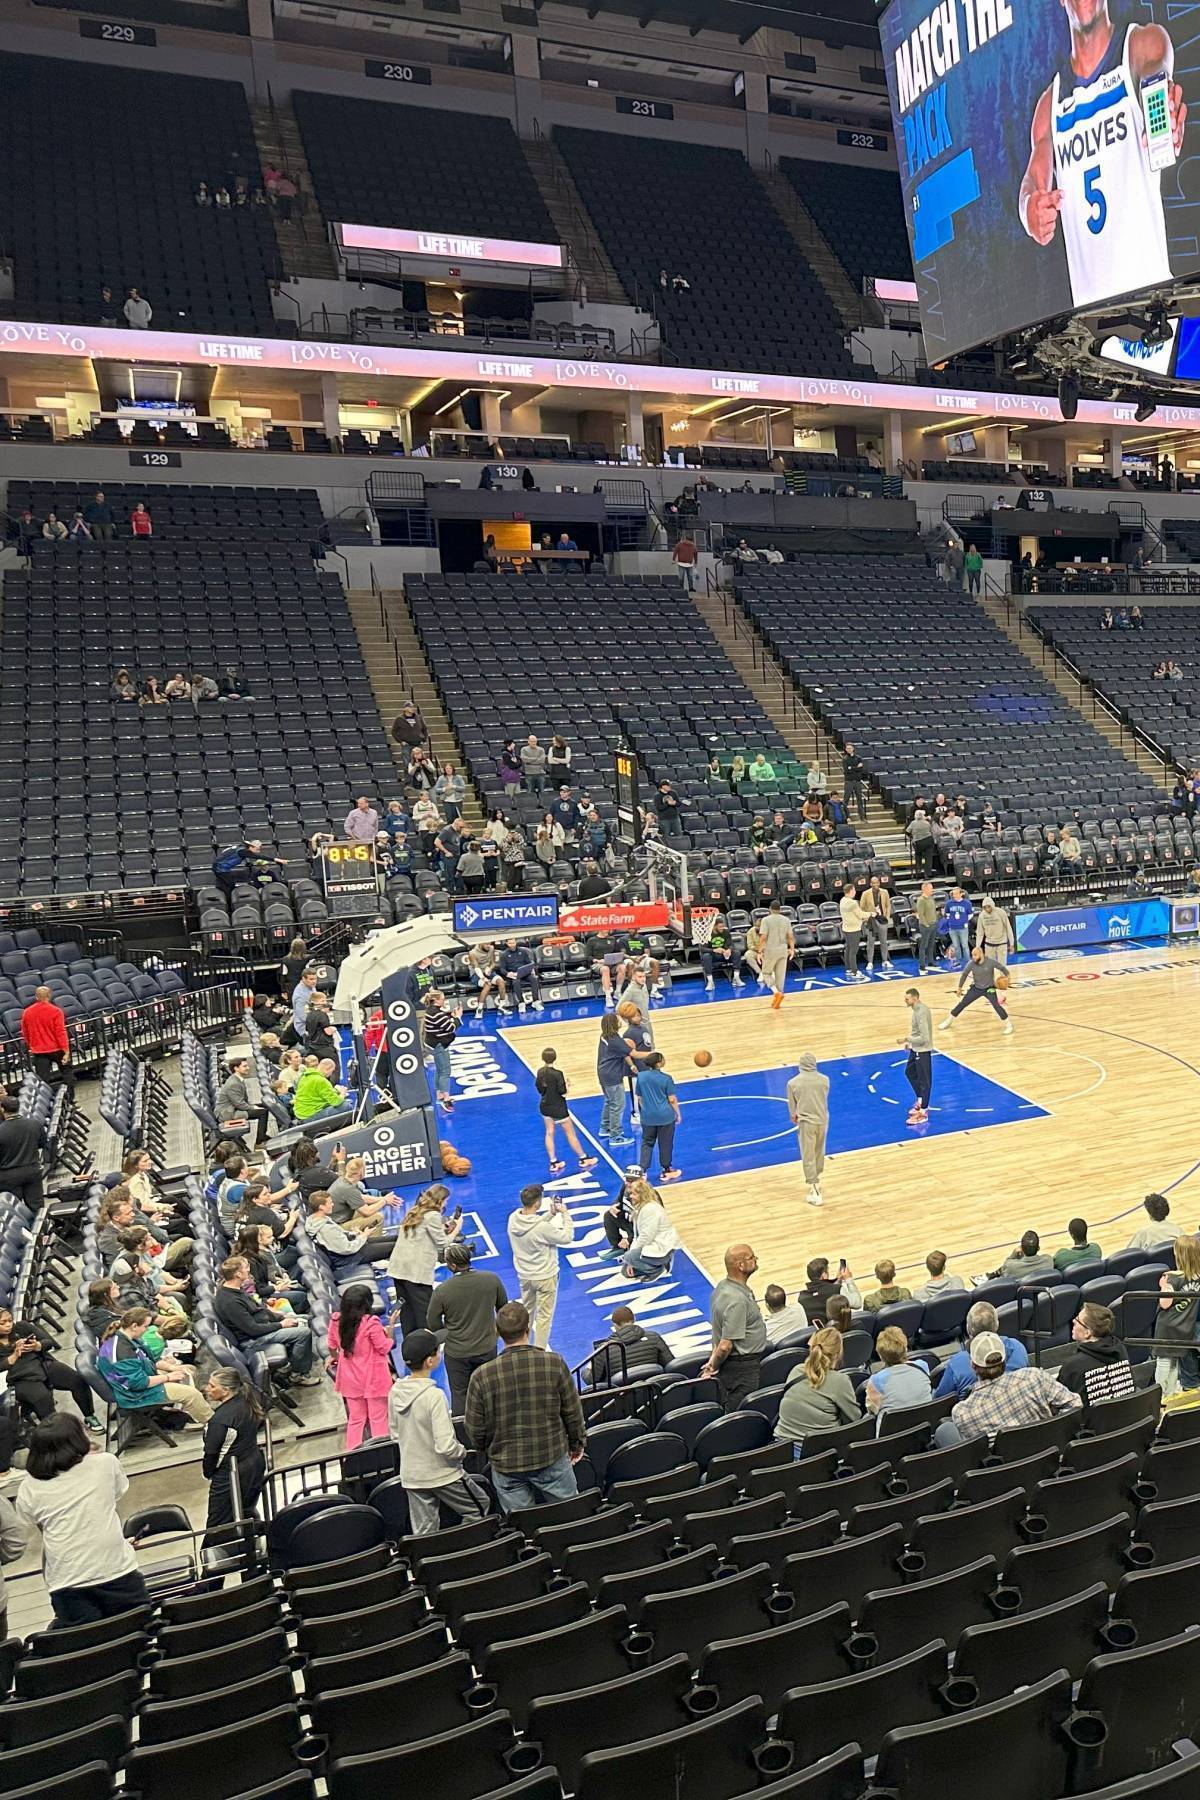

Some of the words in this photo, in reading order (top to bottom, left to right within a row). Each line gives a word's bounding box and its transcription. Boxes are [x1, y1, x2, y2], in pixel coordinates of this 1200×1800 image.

[102, 24, 134, 42] 229
[895, 0, 960, 114] MATCH
[384, 64, 413, 81] 230
[632, 100, 655, 116] 231
[903, 81, 952, 178] PACK
[851, 133, 874, 148] 232
[1057, 112, 1127, 169] WOLVES
[1083, 165, 1107, 235] 5
[142, 453, 169, 466] 129
[496, 466, 518, 478] 130
[1028, 491, 1045, 501] 132
[342, 882, 376, 892] TISSOT
[482, 905, 552, 921] PENTAIR
[1049, 922, 1086, 933] PENTAIR
[1108, 925, 1131, 938] MOVE
[365, 1156, 427, 1178] ENTER
